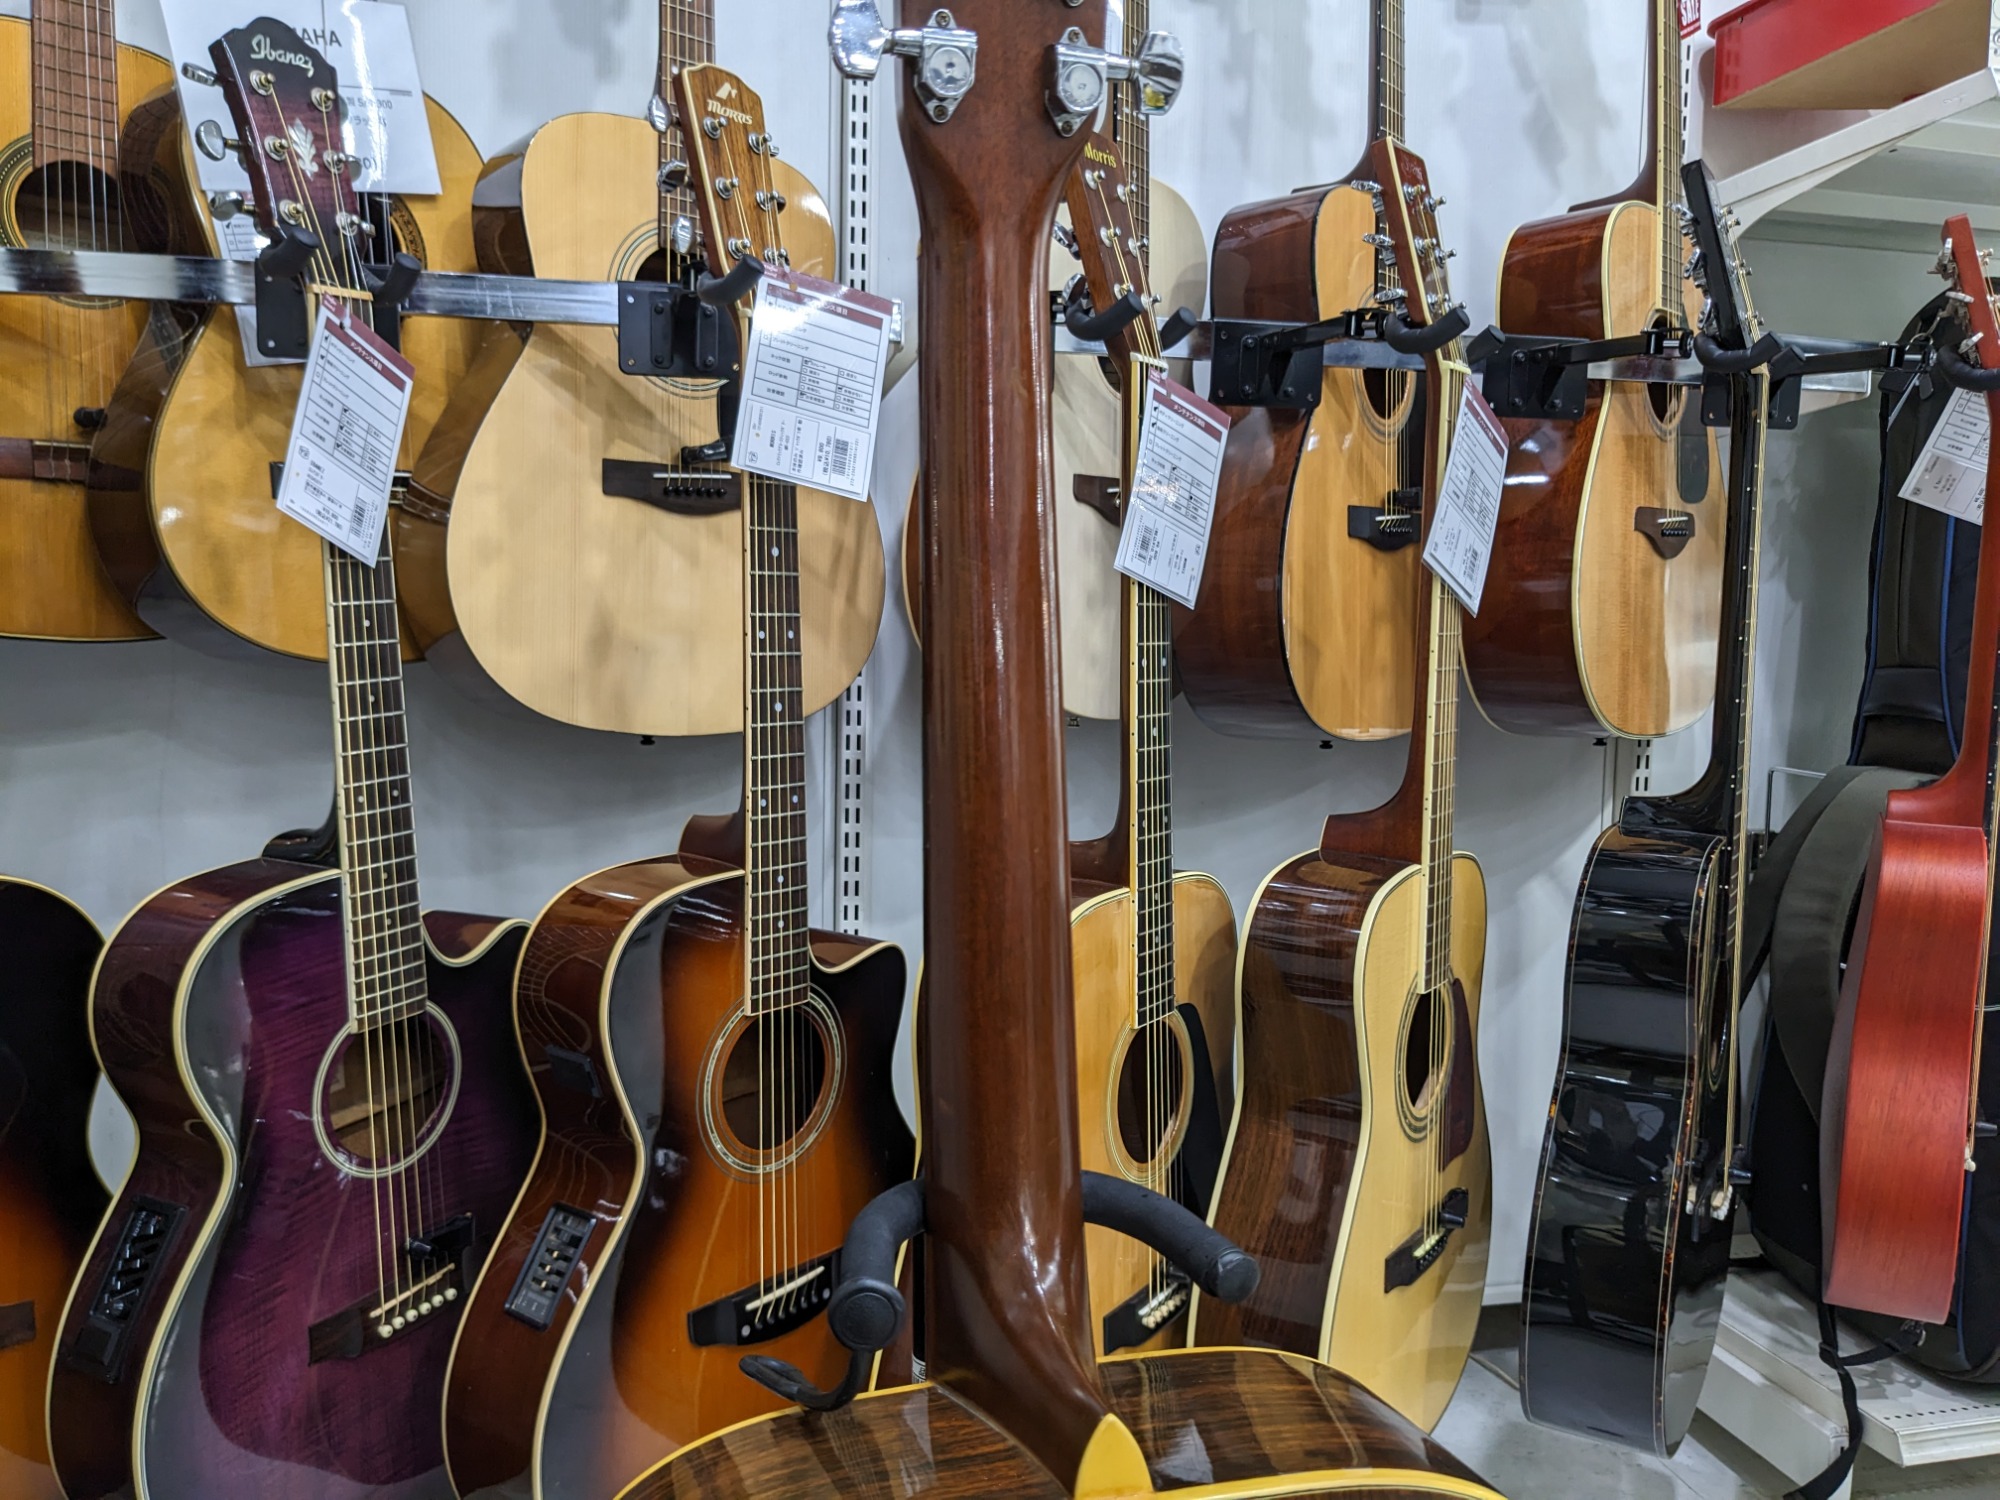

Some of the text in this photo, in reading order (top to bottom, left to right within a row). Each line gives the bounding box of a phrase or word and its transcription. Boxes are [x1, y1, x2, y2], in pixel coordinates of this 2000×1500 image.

[294, 28, 342, 48] AHA
[250, 34, 314, 78] Ibanez
[1083, 142, 1117, 169] Morris
